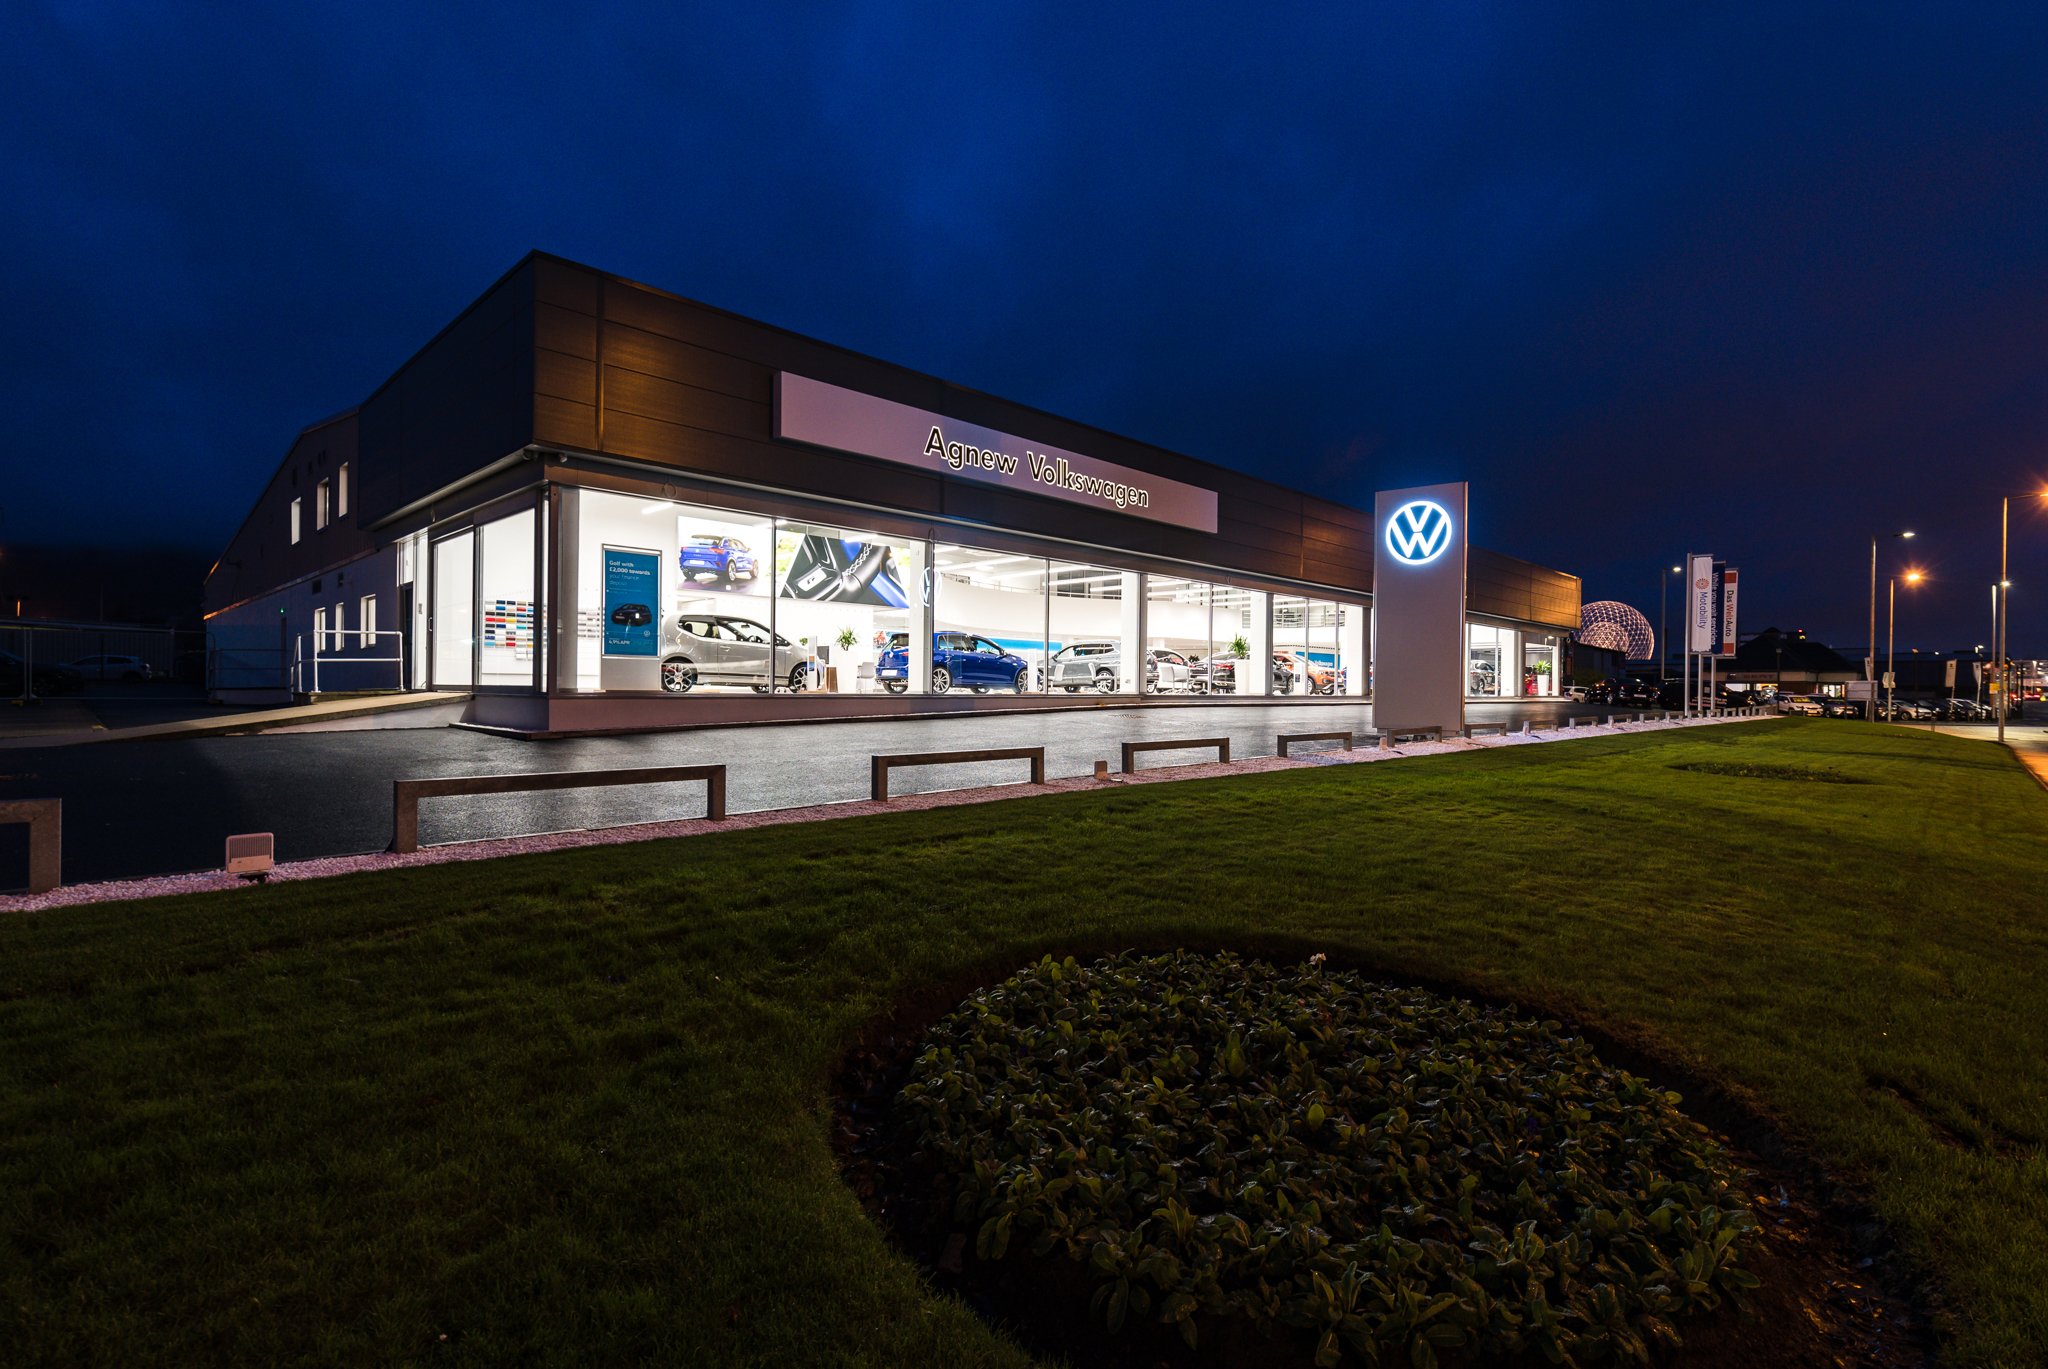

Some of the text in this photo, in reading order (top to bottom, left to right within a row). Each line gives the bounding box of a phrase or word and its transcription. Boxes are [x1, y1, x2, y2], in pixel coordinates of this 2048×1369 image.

[923, 425, 1149, 509] Agnew Volkswagen
[1386, 501, 1452, 565] VW
[1697, 592, 1708, 629] Motability
[1726, 604, 1734, 637] WeltAuto
